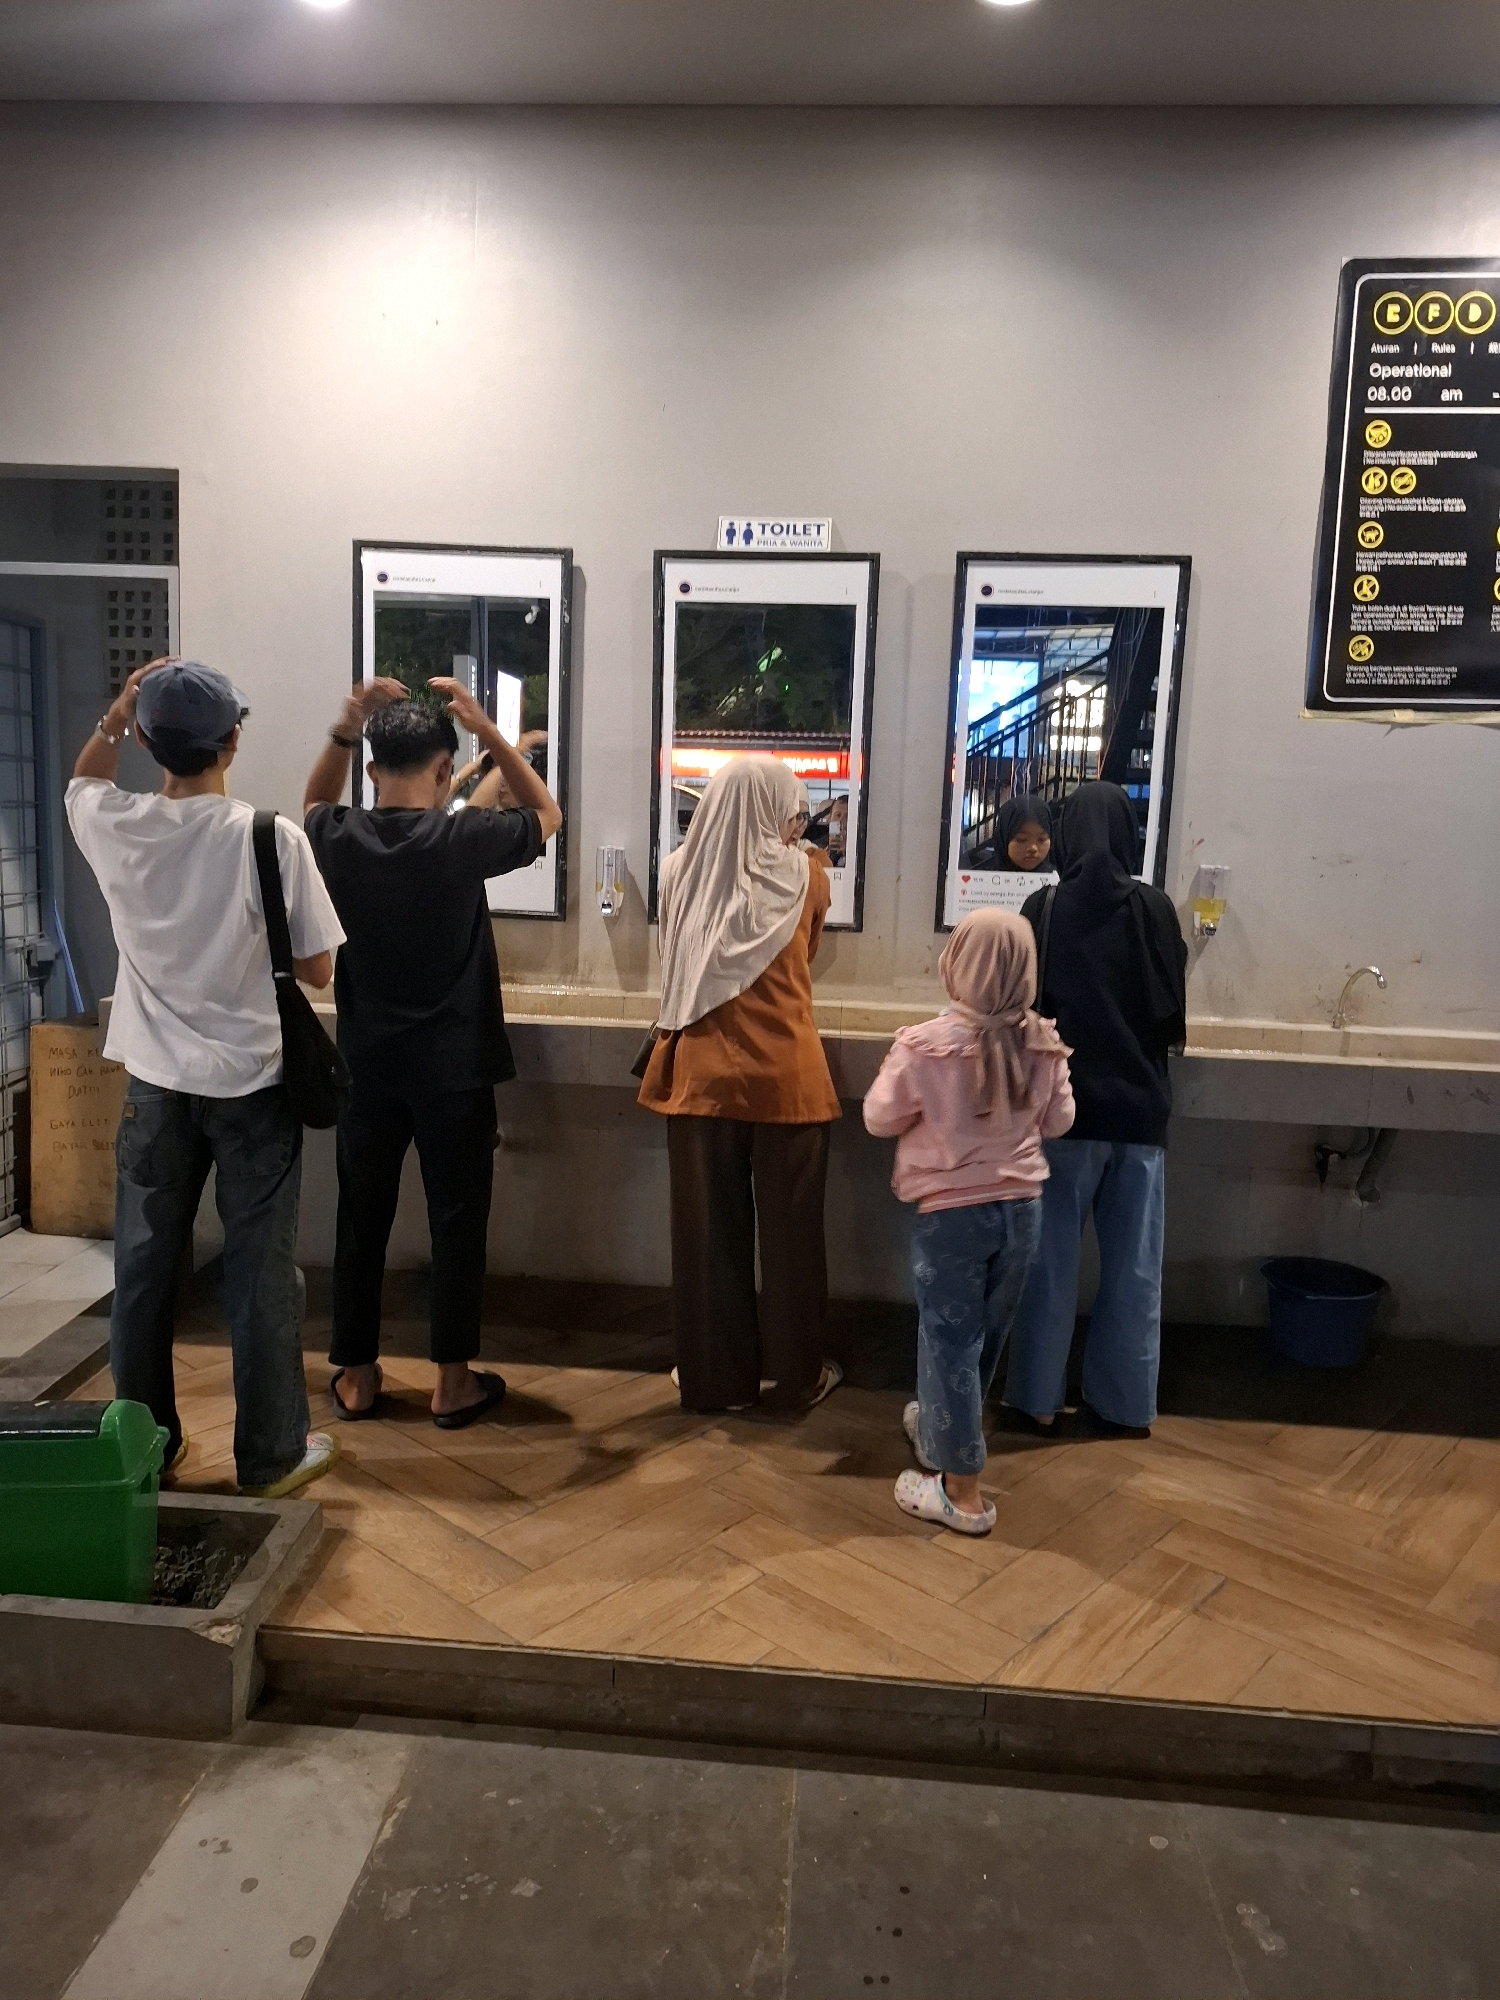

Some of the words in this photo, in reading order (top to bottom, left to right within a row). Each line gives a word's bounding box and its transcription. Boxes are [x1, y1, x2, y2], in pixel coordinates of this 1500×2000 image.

[1371, 341, 1400, 354] Aturan
[1432, 341, 1456, 354] Rules
[1369, 362, 1452, 381] Operational
[1367, 386, 1412, 401] 08.00
[1440, 388, 1463, 401] am
[758, 522, 825, 536] TOILET
[757, 540, 777, 548] PRIA
[789, 540, 823, 548] WANITA
[48, 1047, 78, 1060] MASA
[50, 1119, 75, 1130] GAYA
